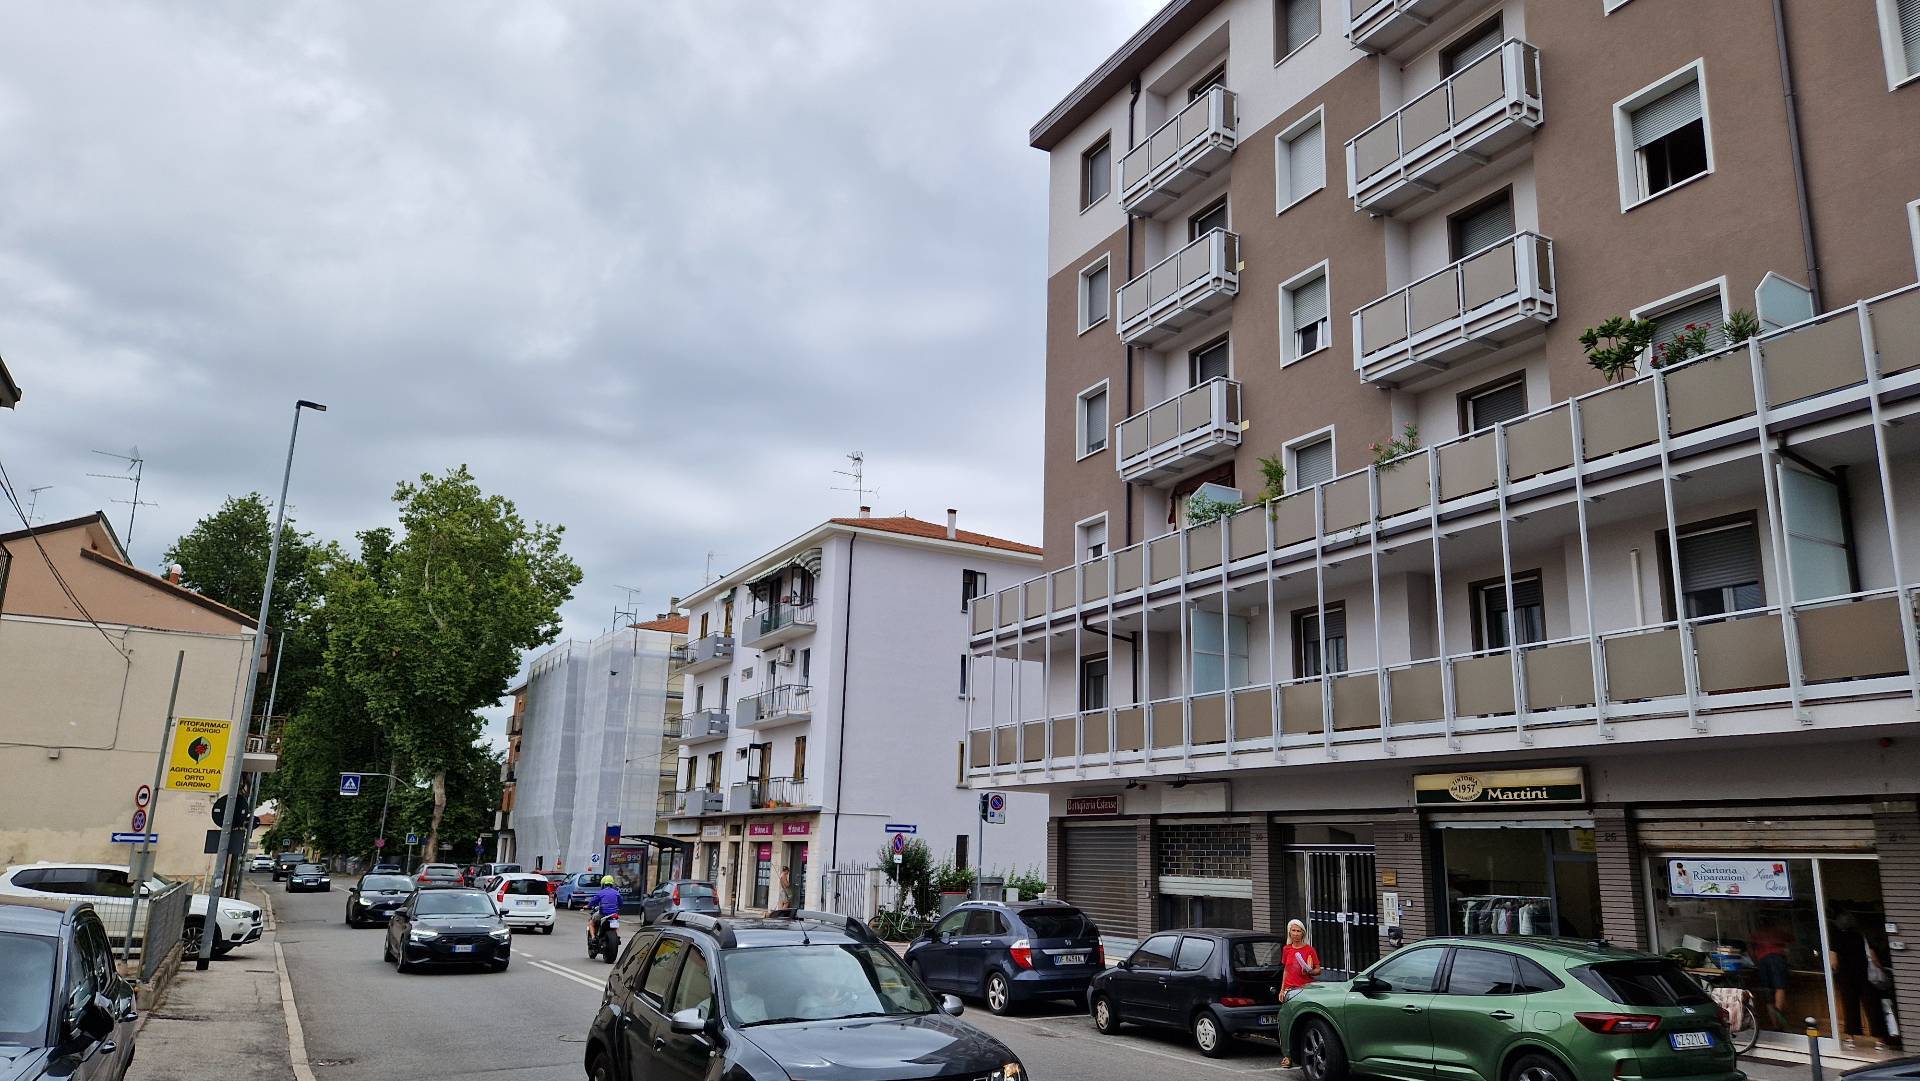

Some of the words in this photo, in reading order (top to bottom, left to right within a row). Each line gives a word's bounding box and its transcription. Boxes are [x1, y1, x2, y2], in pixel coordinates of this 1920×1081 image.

[180, 720, 229, 729] FITOFARMACI
[170, 767, 221, 775] AGRICOLTURA
[1458, 784, 1476, 794] 1957
[1487, 787, 1549, 801] Martini
[1700, 863, 1738, 874] Sartoria
[1693, 870, 1746, 882] Riparazioni
